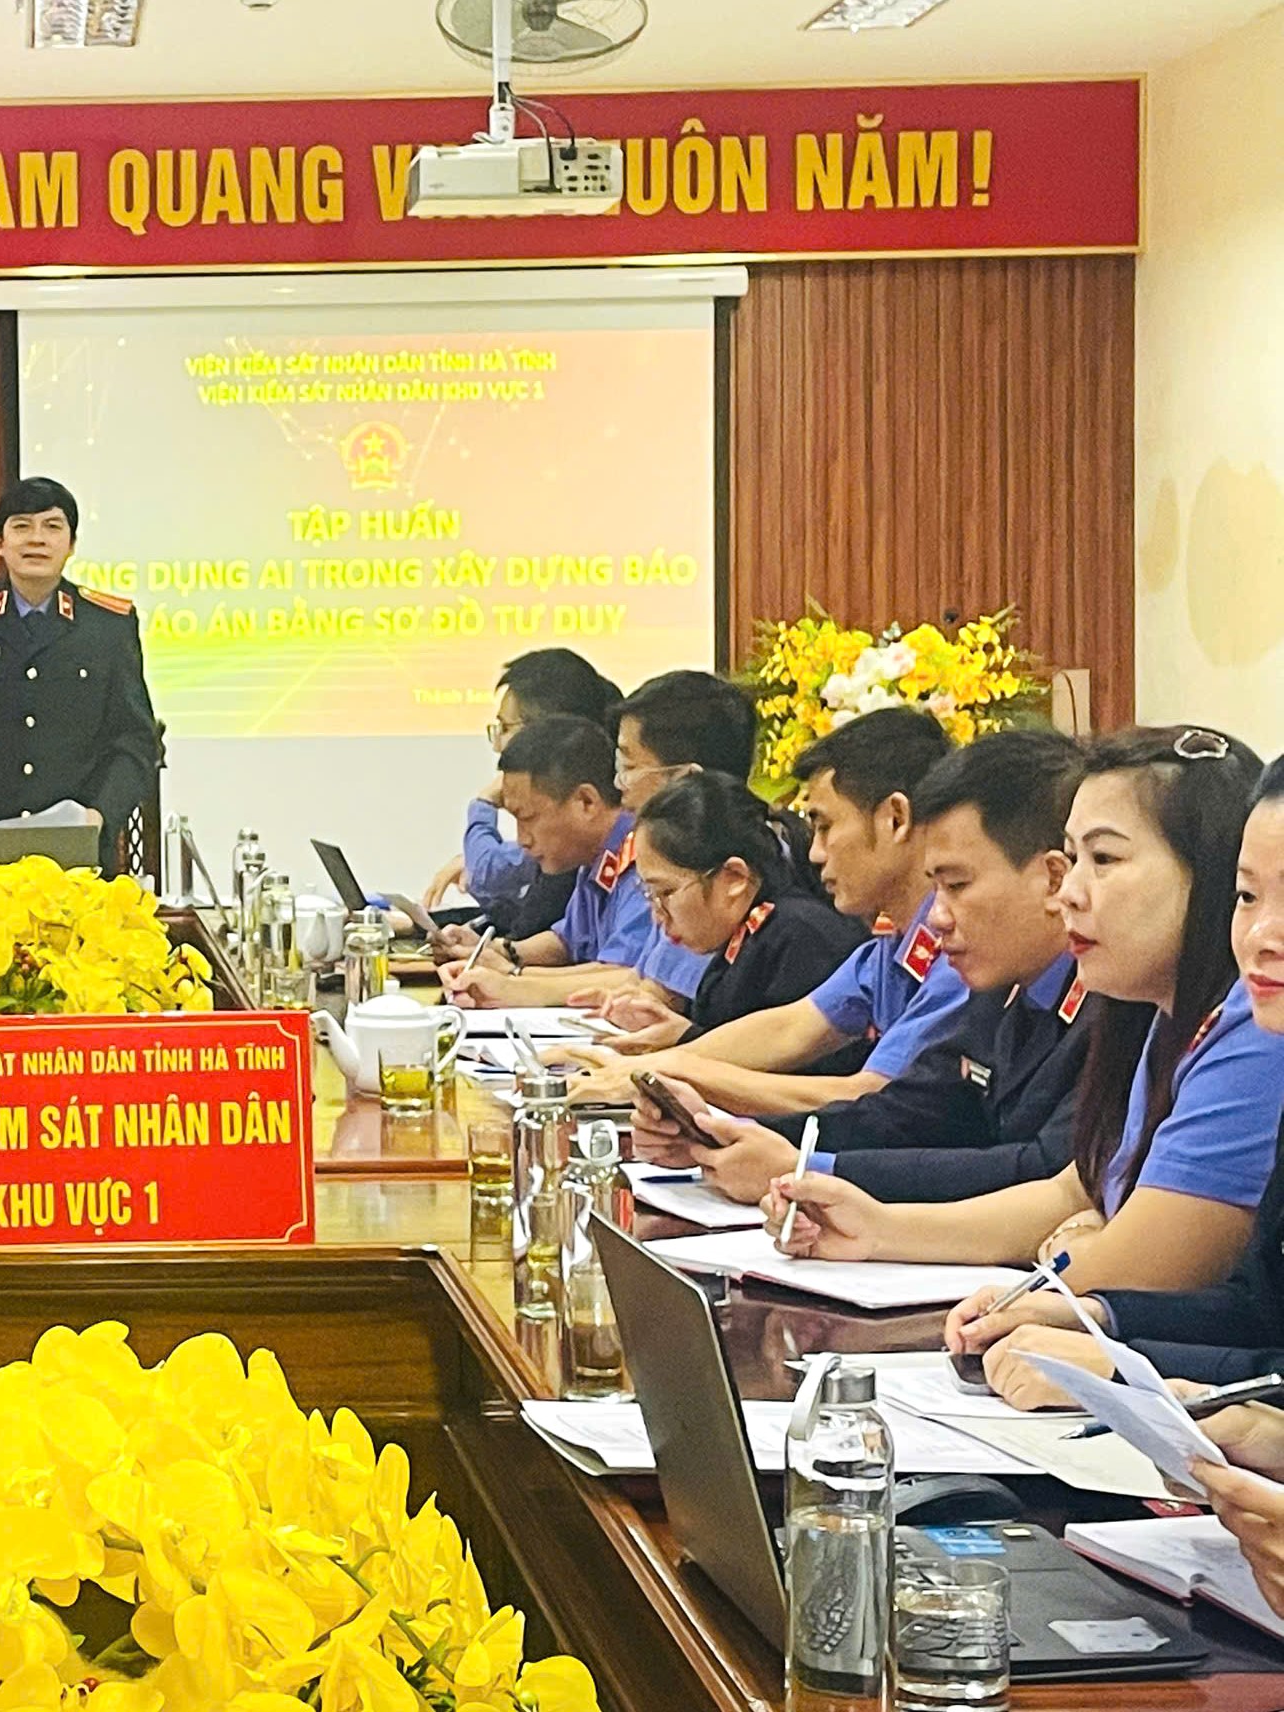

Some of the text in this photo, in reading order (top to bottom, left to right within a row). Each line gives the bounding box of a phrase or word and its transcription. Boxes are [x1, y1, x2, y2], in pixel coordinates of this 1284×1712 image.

[108, 144, 344, 236] QUANG
[604, 117, 768, 216] UÔN
[532, 382, 545, 400] 1
[287, 499, 462, 548] TẬP HUẤN
[147, 560, 251, 597] DỤNG
[258, 560, 294, 591] AI
[301, 556, 424, 591] TRONG
[431, 549, 497, 588] XÂY
[505, 553, 614, 593] DỰNG
[622, 547, 699, 586] BÁO
[140, 602, 198, 638] ÁO
[206, 601, 259, 638] ÁN
[491, 602, 548, 636] TƯ
[553, 603, 628, 635] DUY
[22, 1046, 85, 1076] NHÂN
[90, 1044, 137, 1074] DÂN
[141, 1041, 193, 1073] TỈNH
[199, 1042, 229, 1072] HÀ
[234, 1043, 286, 1070] TĨNH
[39, 1095, 104, 1150] SÁT
[113, 1093, 210, 1148] NHÂN
[220, 1091, 292, 1146] DÂN
[64, 1176, 132, 1236] VỰC
[143, 1180, 159, 1225] 1
